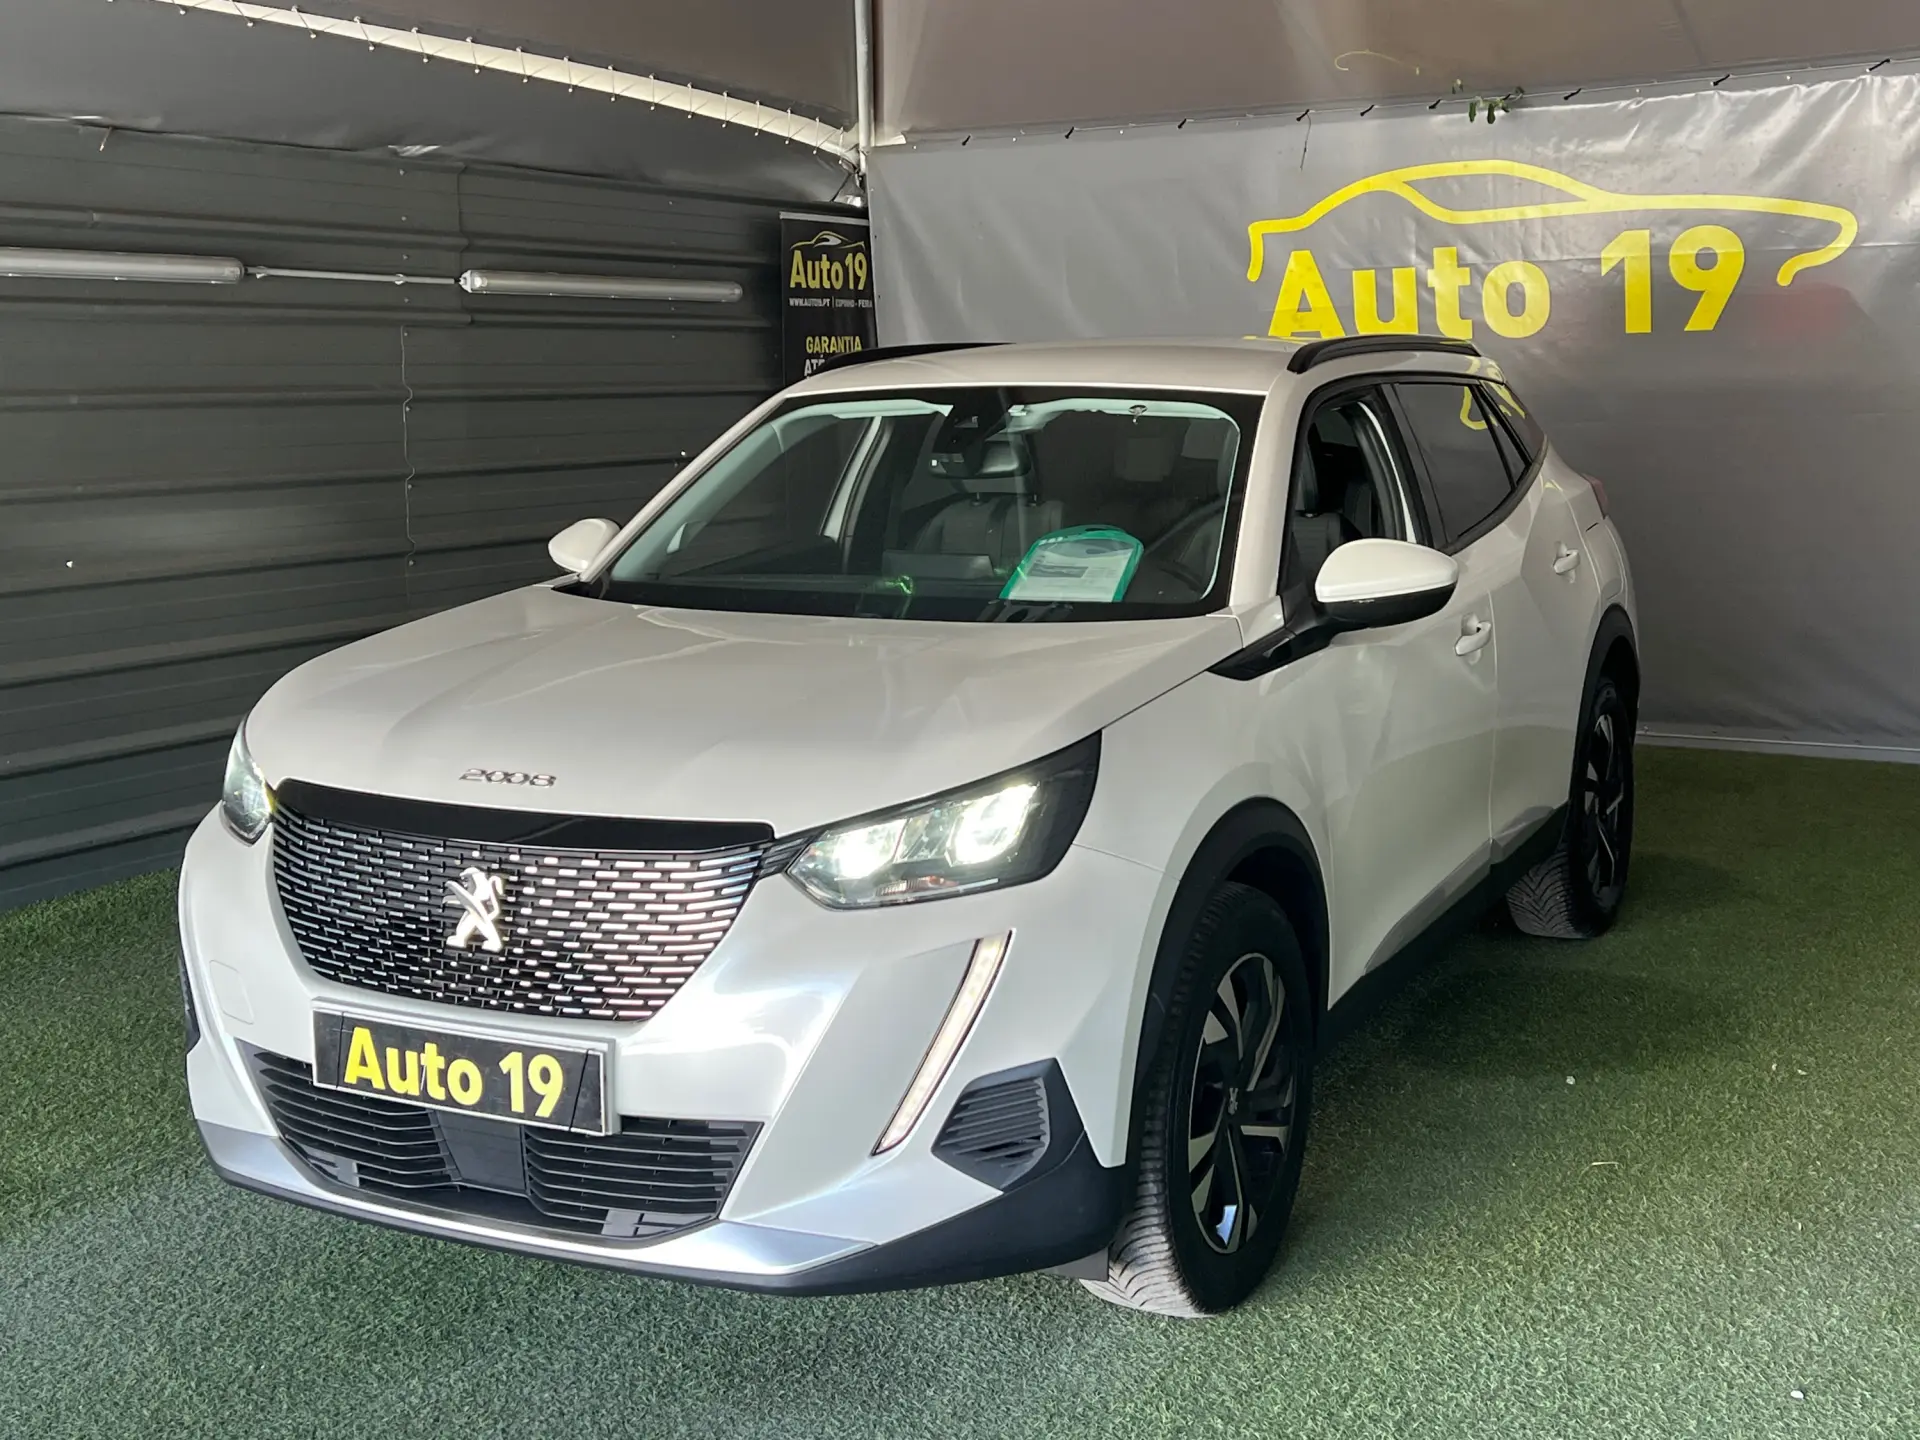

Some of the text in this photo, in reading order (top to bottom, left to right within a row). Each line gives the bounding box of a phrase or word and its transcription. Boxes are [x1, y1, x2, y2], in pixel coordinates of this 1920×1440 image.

[789, 250, 868, 291] Auto 19
[1267, 224, 1746, 340] Auto 19
[806, 335, 863, 354] GARANTIA
[459, 768, 557, 787] 2008
[343, 1026, 564, 1119] Auto 19
